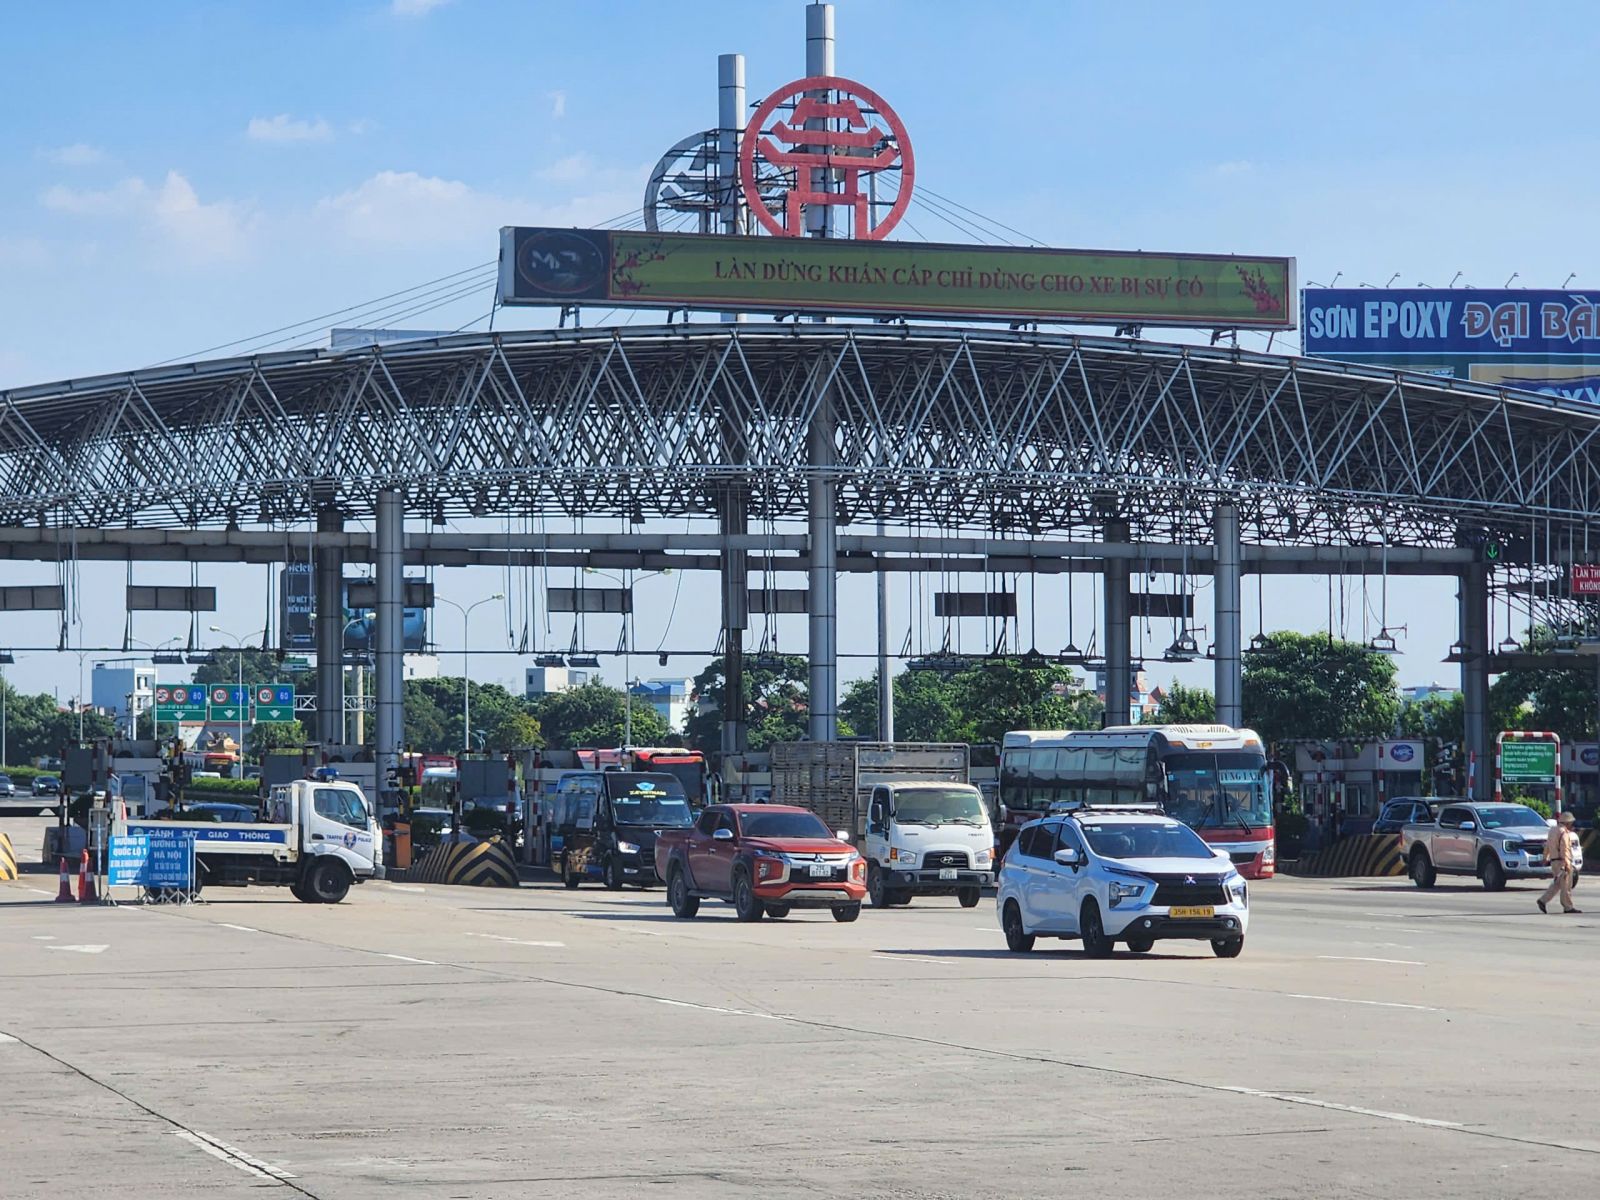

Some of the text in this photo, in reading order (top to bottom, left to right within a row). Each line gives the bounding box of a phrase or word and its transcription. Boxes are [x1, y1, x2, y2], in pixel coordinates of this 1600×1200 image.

[715, 257, 756, 279] LÀN
[762, 259, 822, 282] DỪNG
[978, 267, 1036, 291] DÙNG
[1040, 273, 1085, 293] CHO
[1090, 275, 1116, 294] XE
[1120, 277, 1140, 298] BỊ
[1145, 276, 1172, 299] SỰ
[1309, 304, 1357, 339] SƠN
[1364, 301, 1453, 339] EPOXY
[1460, 301, 1530, 347] ĐẠI
[208, 831, 230, 839] GIAO
[239, 830, 270, 840] THÔNG
